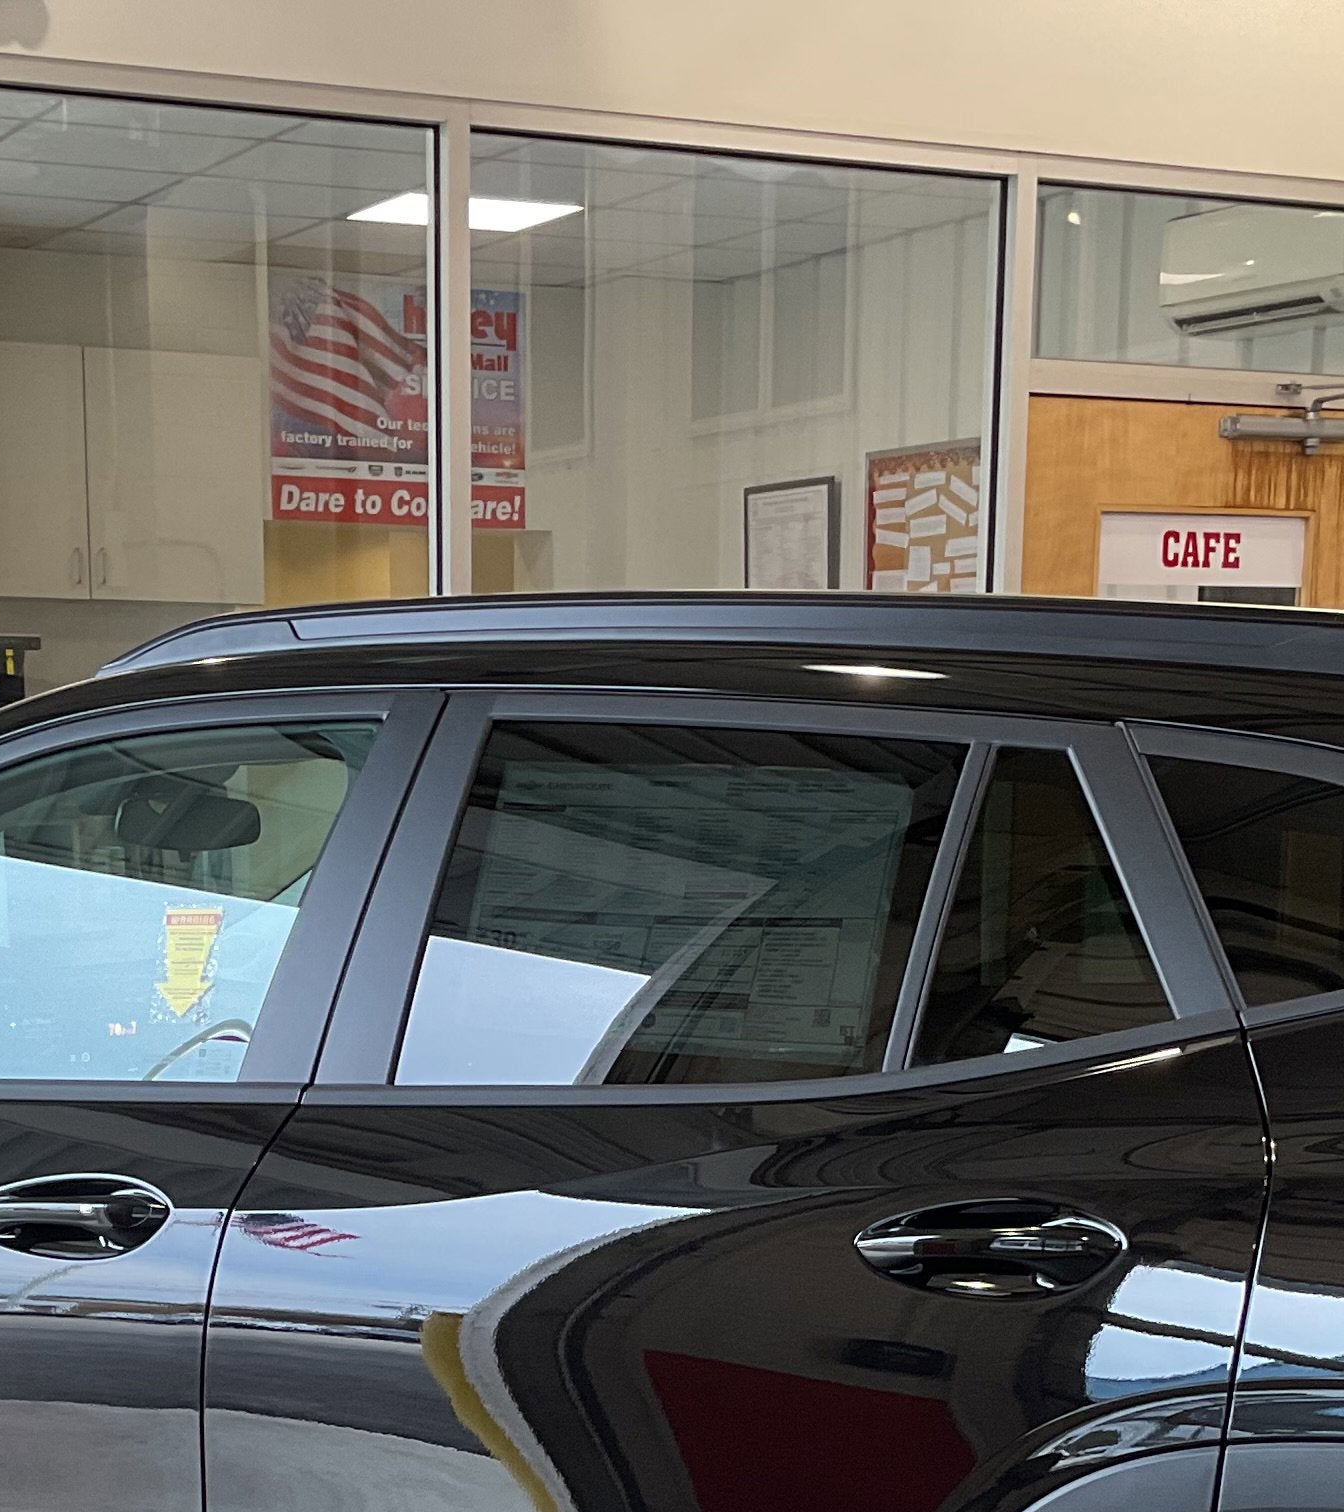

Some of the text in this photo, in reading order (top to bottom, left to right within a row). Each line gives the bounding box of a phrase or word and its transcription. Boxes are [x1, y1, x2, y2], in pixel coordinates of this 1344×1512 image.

[403, 294, 517, 352] hey
[404, 374, 516, 401] SICE
[281, 431, 517, 456] factory trained for ehicle!
[376, 417, 403, 432] Our
[493, 424, 517, 438] are
[279, 484, 521, 521] Dare to Coare!
[1161, 530, 1241, 569] CAFE
